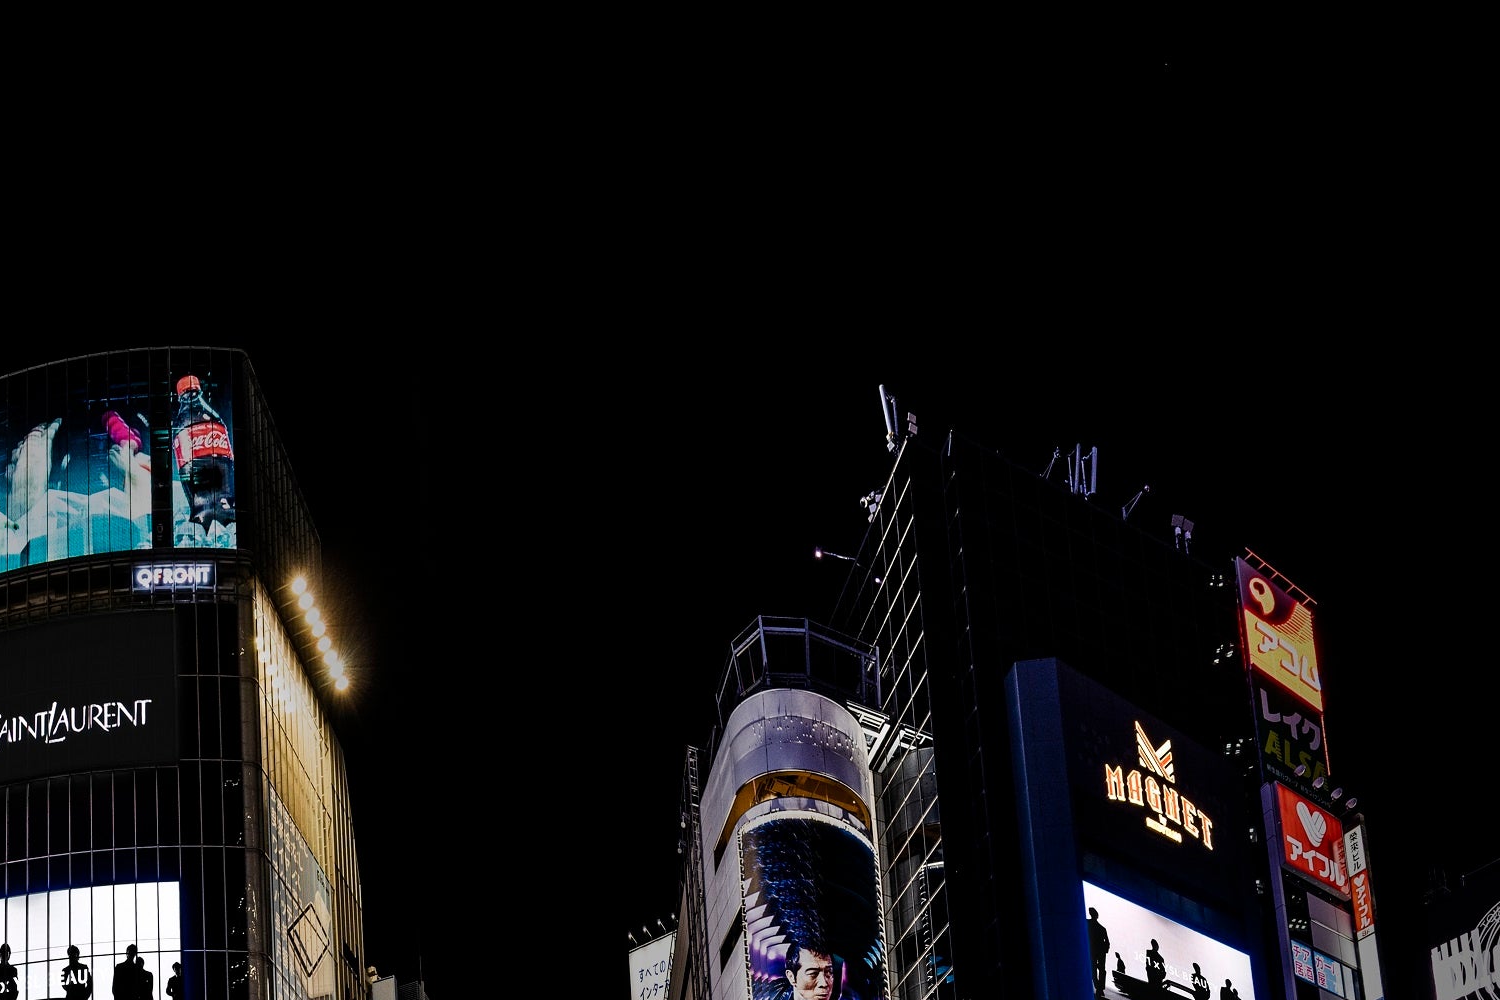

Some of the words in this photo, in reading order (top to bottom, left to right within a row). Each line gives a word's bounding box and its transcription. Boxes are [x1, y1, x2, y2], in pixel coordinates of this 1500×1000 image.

[136, 566, 211, 589] QFRONT
[1255, 620, 1322, 693] アコム
[1259, 687, 1321, 752] レイク
[1104, 763, 1214, 851] MAGNET
[1286, 834, 1345, 888] アイフル
[1355, 884, 1371, 930] アイフル
[1162, 962, 1180, 977] YSL
[1182, 972, 1220, 994] BEAUTY
[1294, 960, 1327, 988] 居酒屋
